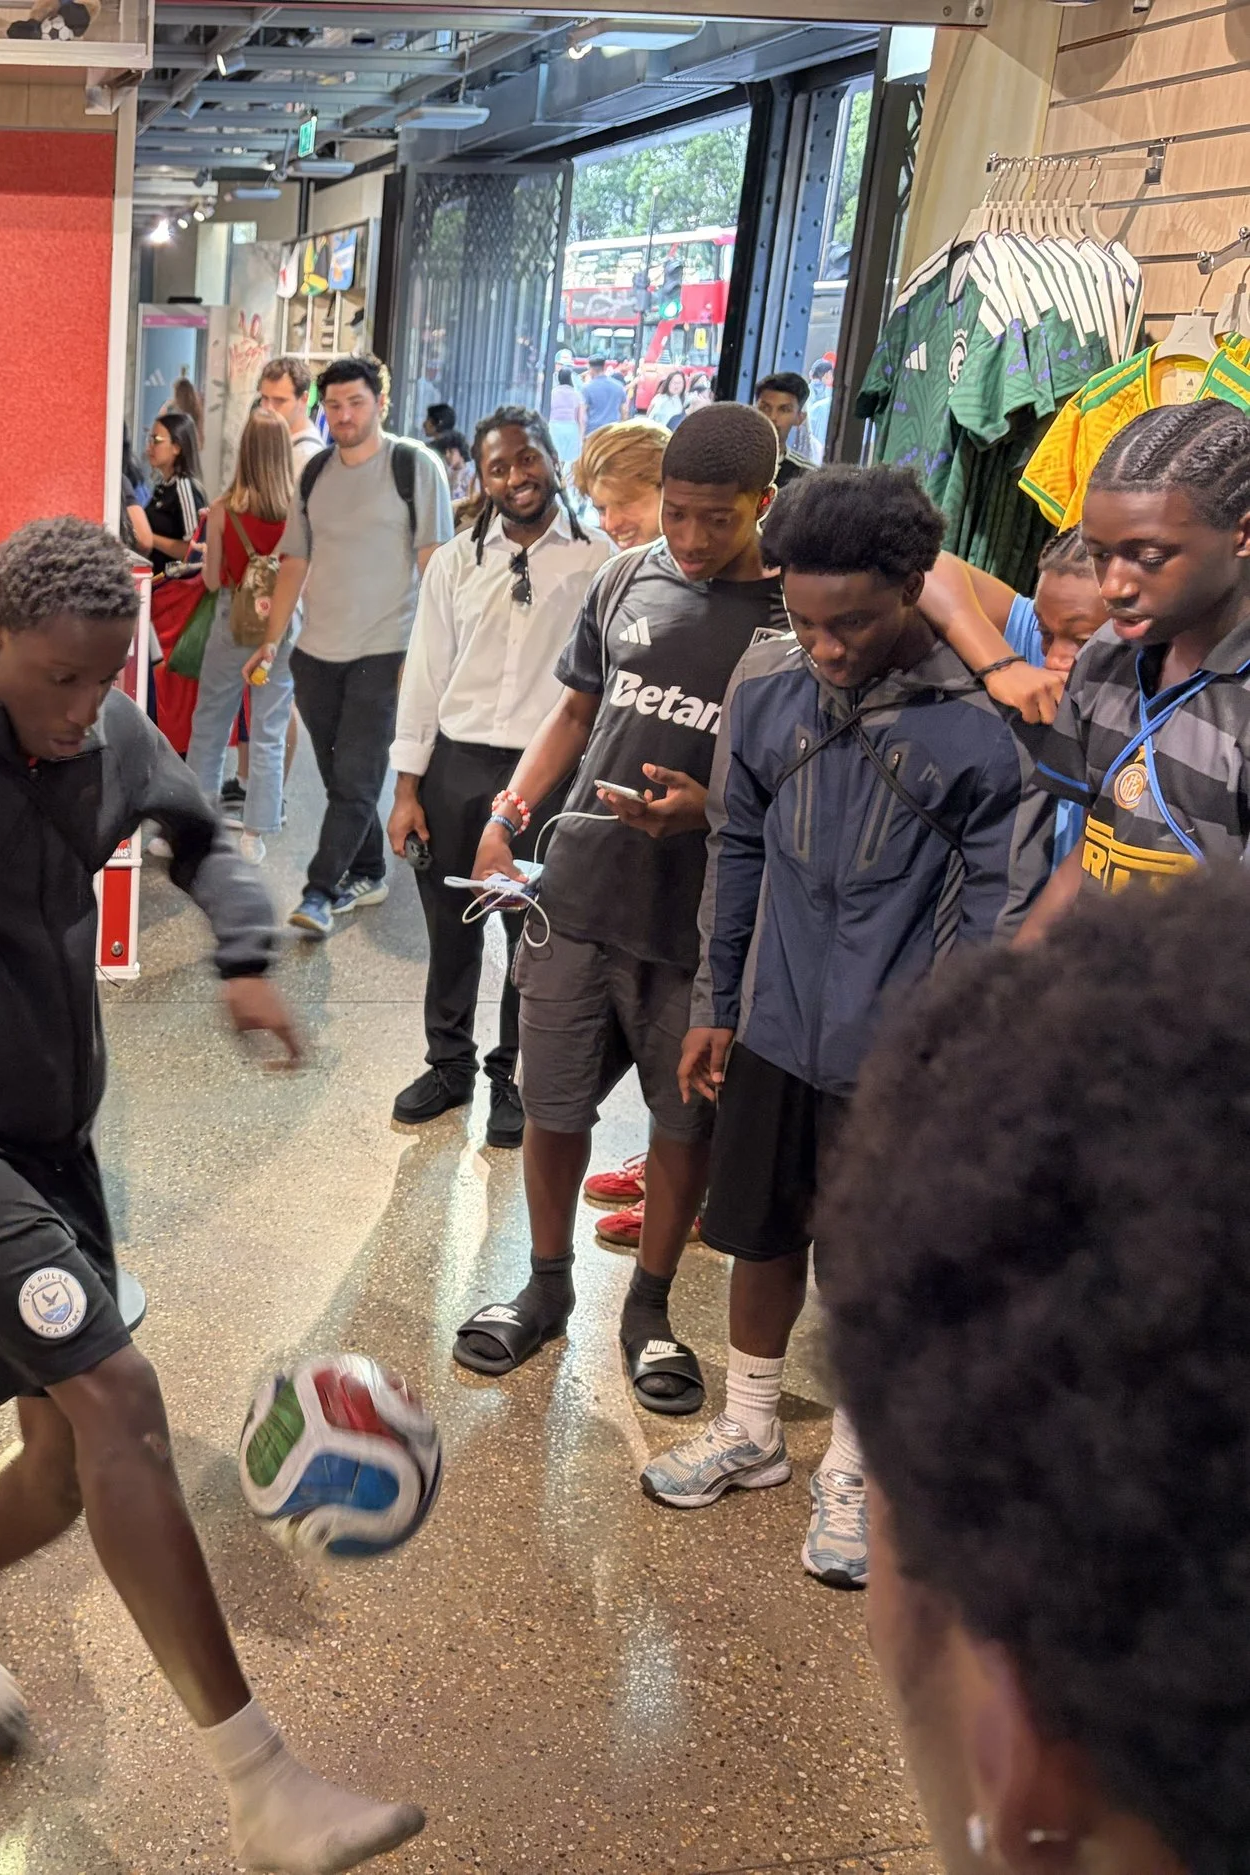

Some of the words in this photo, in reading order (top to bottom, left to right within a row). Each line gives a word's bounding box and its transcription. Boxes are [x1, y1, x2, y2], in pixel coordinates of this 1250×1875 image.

[23, 1283, 36, 1304] THE
[37, 1272, 69, 1284] PULSE
[38, 1307, 82, 1334] ACADEMY
[486, 1305, 518, 1319] NIKE
[646, 1339, 678, 1353] NIKE
